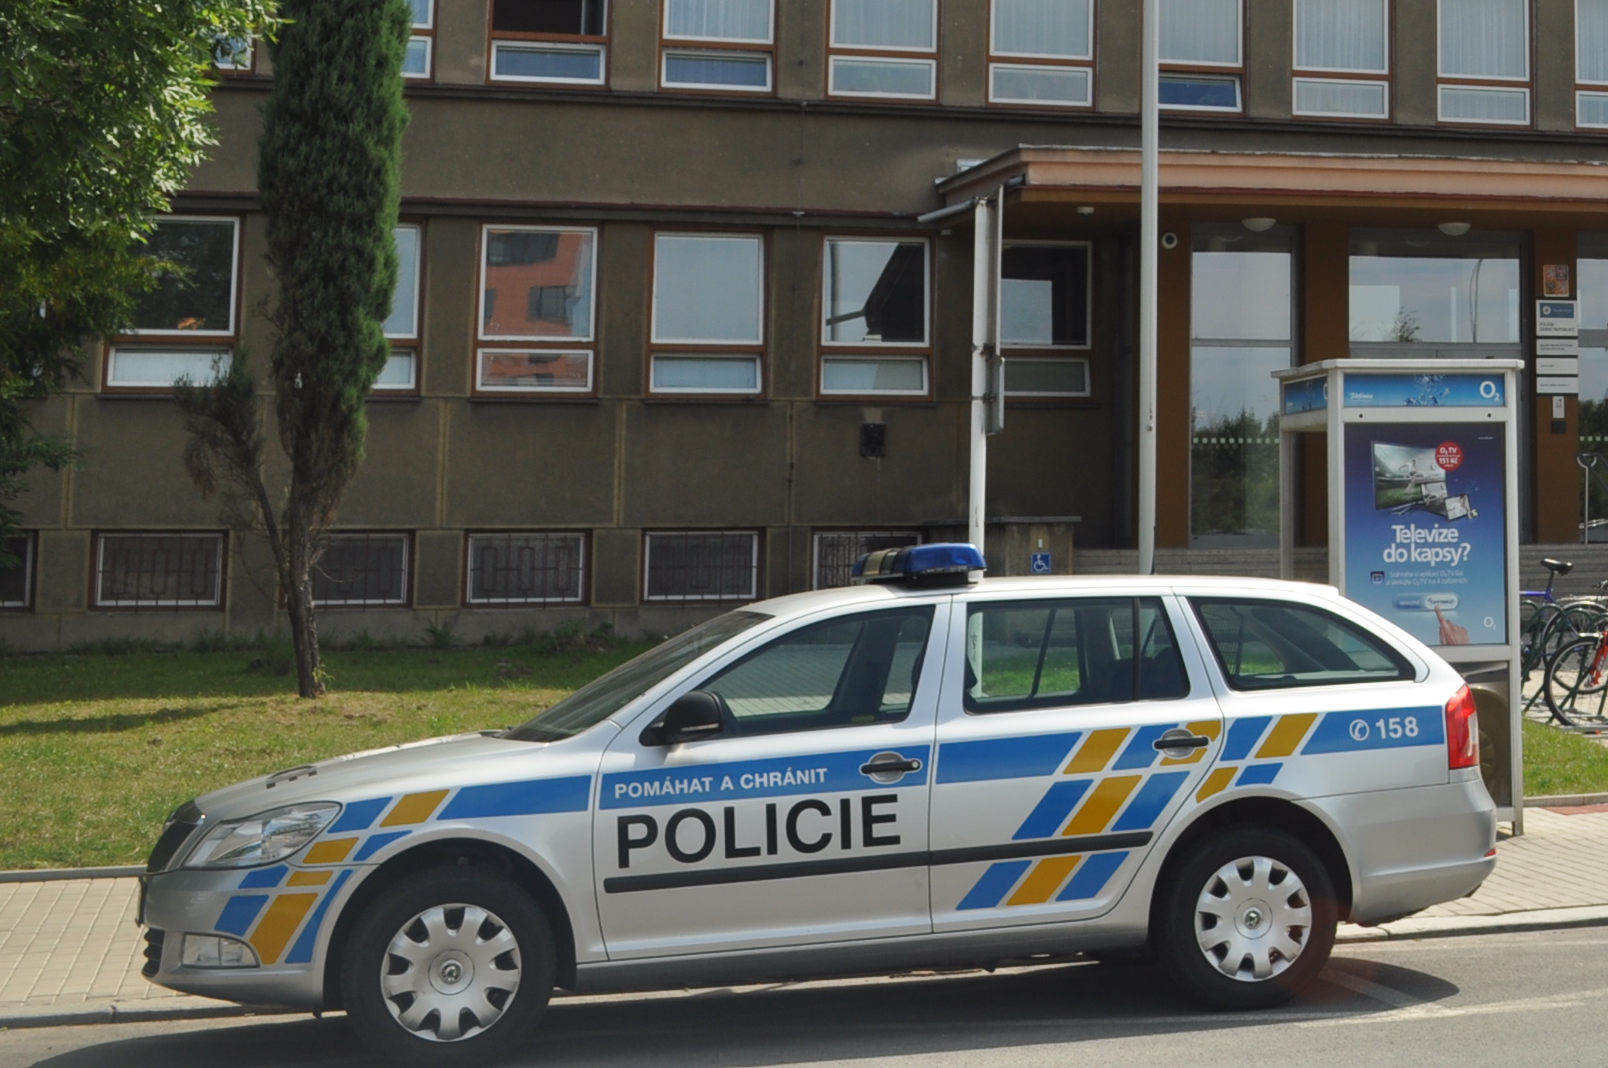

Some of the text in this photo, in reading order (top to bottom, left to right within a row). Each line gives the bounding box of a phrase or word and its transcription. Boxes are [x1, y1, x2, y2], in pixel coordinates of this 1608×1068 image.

[1391, 523, 1459, 544] Televize
[1383, 542, 1471, 567] do kapsy?
[1375, 716, 1419, 740] 158
[614, 767, 828, 799] POMÁHAT A CHRÁNIT
[617, 793, 901, 869] POLICIE
